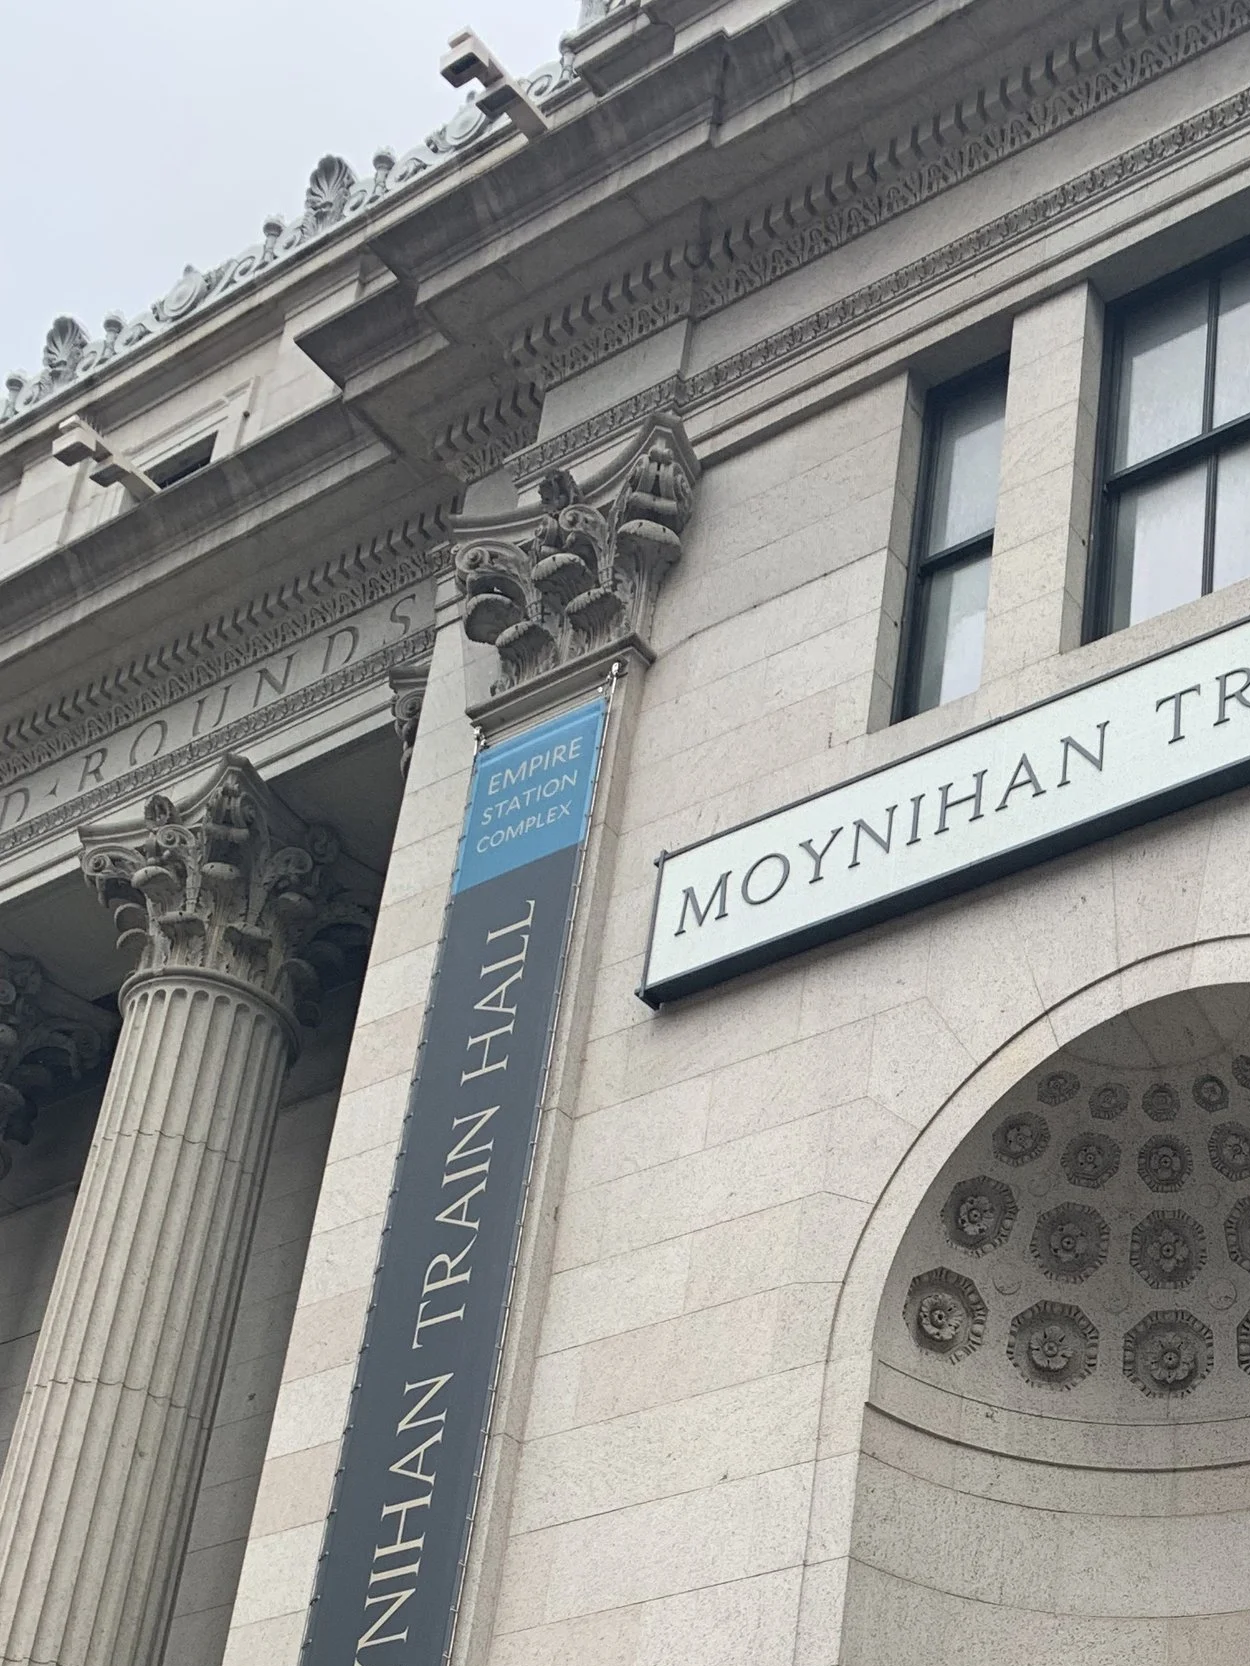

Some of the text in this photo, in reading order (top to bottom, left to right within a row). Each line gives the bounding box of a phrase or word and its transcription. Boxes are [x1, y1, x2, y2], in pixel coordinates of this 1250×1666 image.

[77, 593, 416, 792] ROUNDS
[476, 800, 571, 853] COMPLEX
[481, 769, 578, 826] STATION
[487, 737, 583, 796] EMPIRE
[674, 721, 1110, 937] MOYNIHAN
[412, 1105, 500, 1350] TRAIN
[460, 899, 536, 1087] HALL
